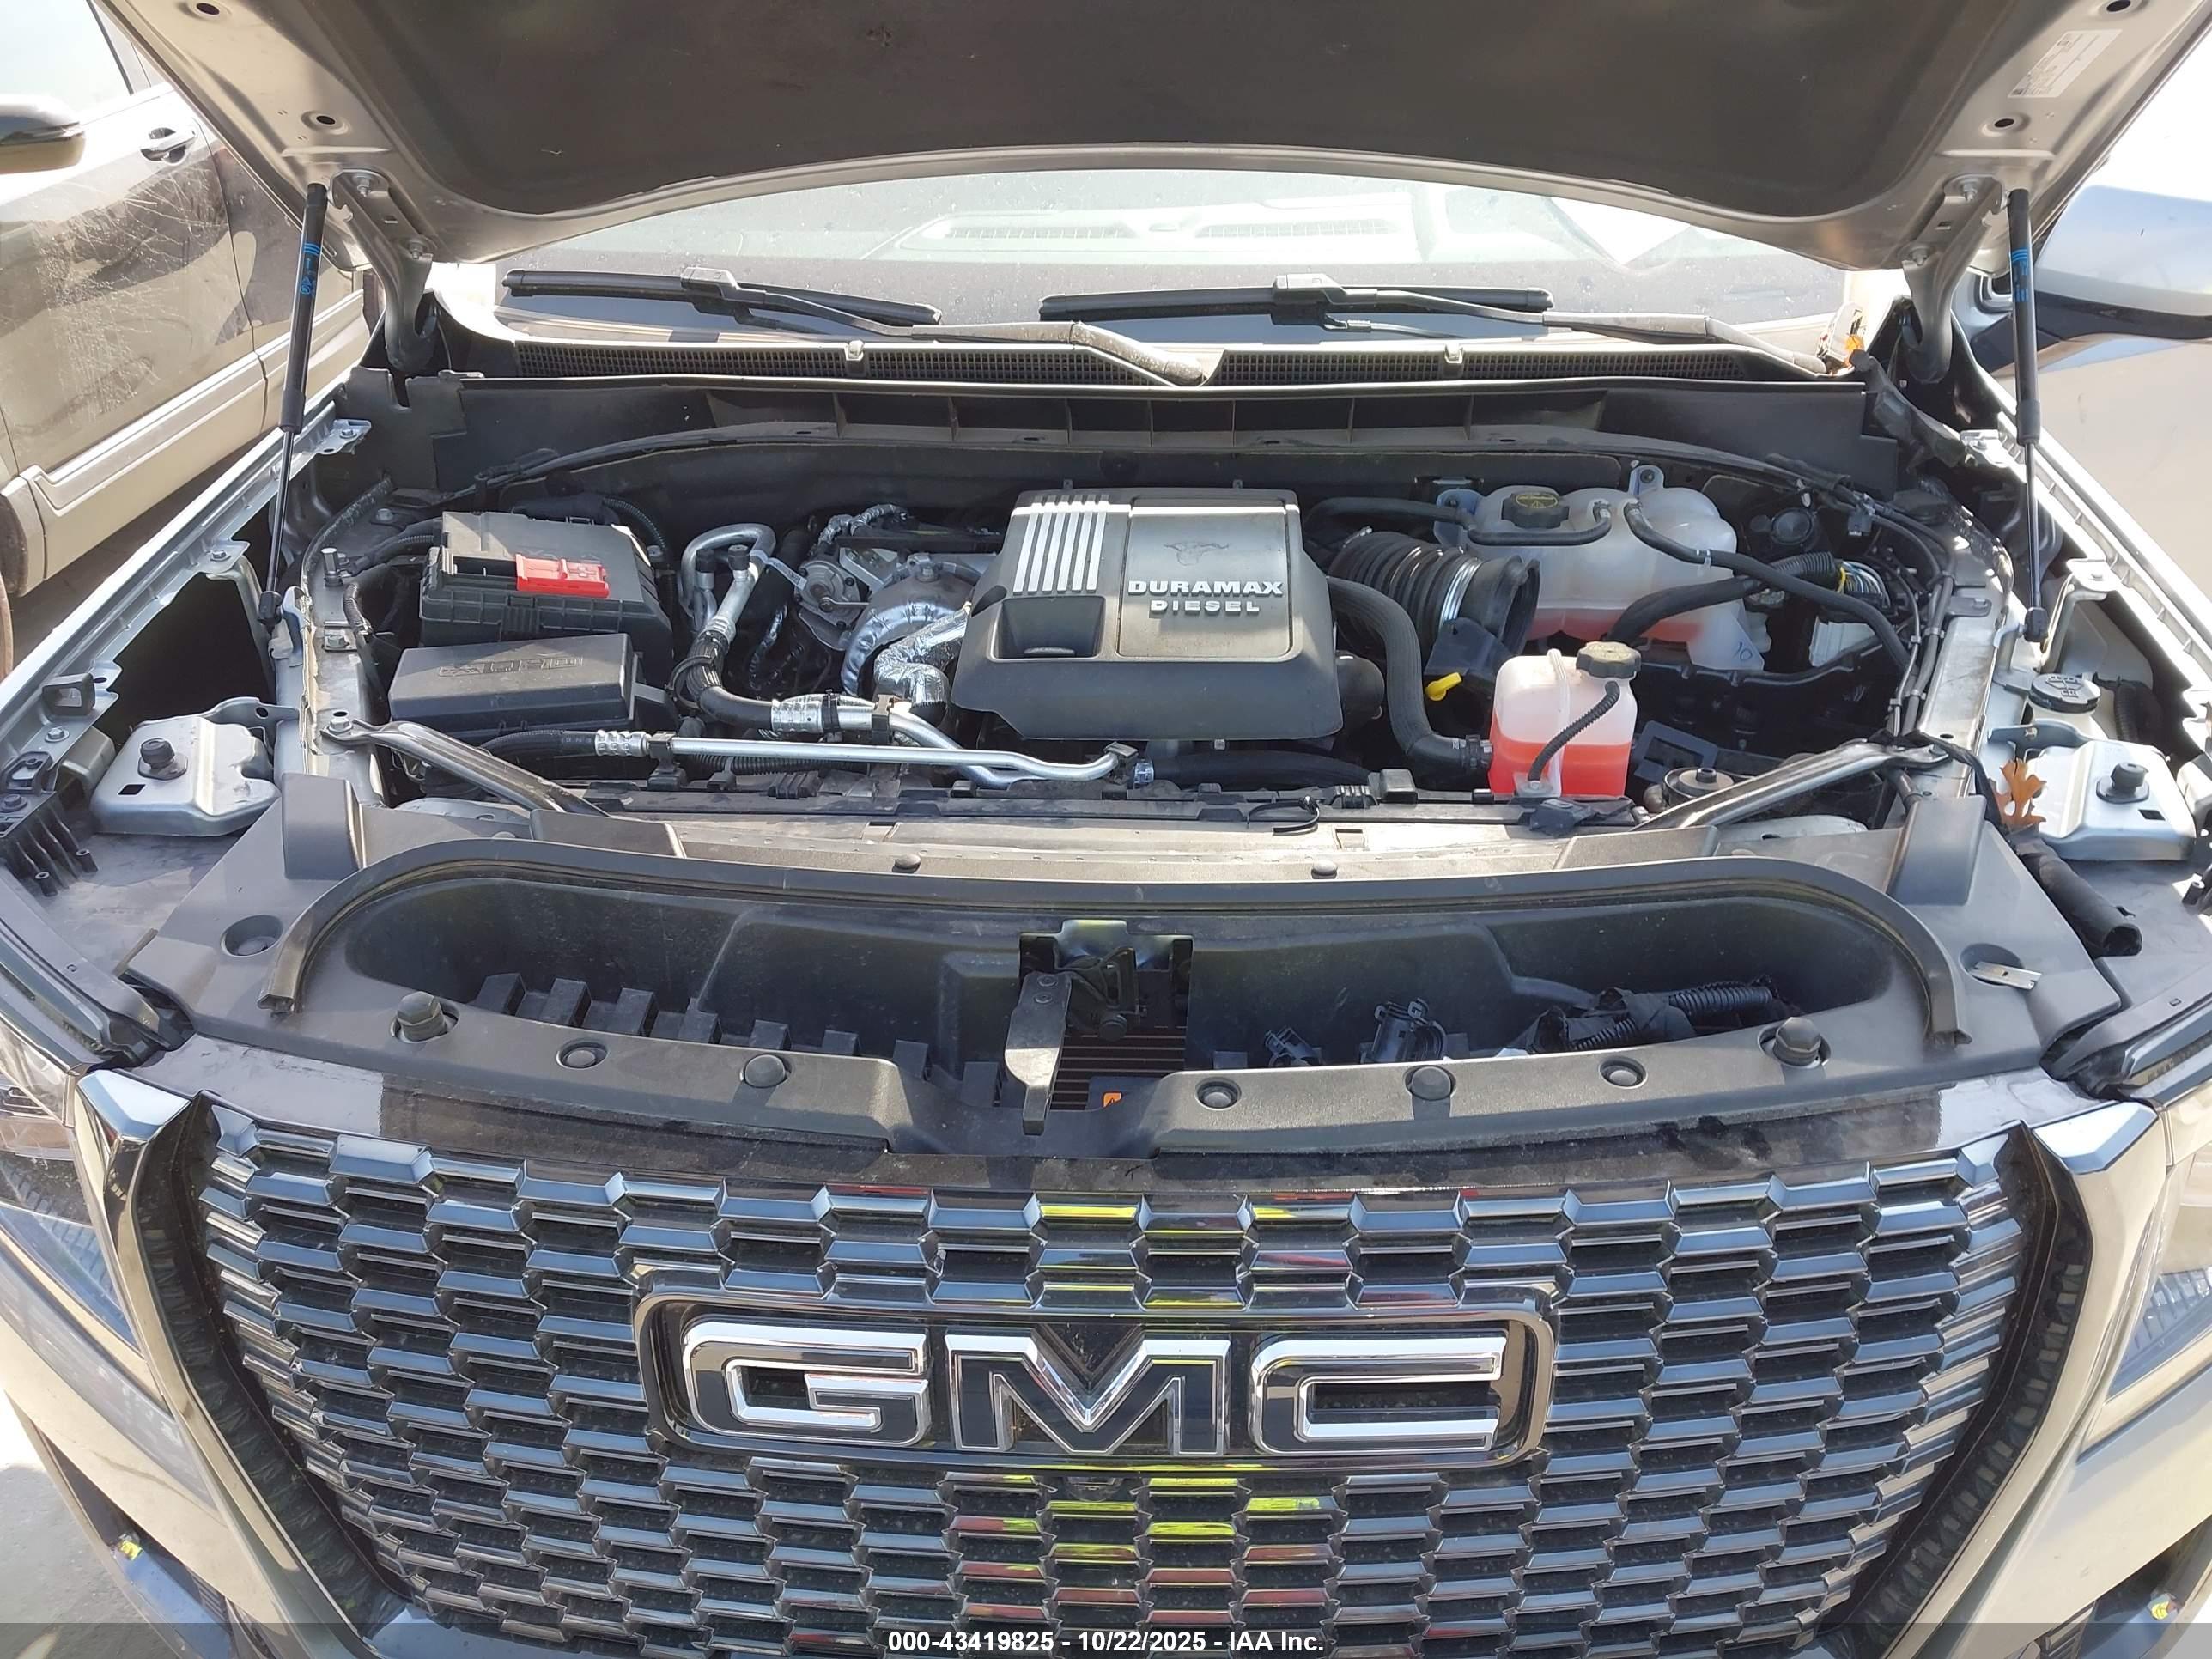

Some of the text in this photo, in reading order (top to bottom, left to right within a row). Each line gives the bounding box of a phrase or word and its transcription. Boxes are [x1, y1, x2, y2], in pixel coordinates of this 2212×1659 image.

[1127, 580, 1283, 597] DURAMAX
[1150, 600, 1260, 613] DIESEL
[683, 1322, 1509, 1456] GMC
